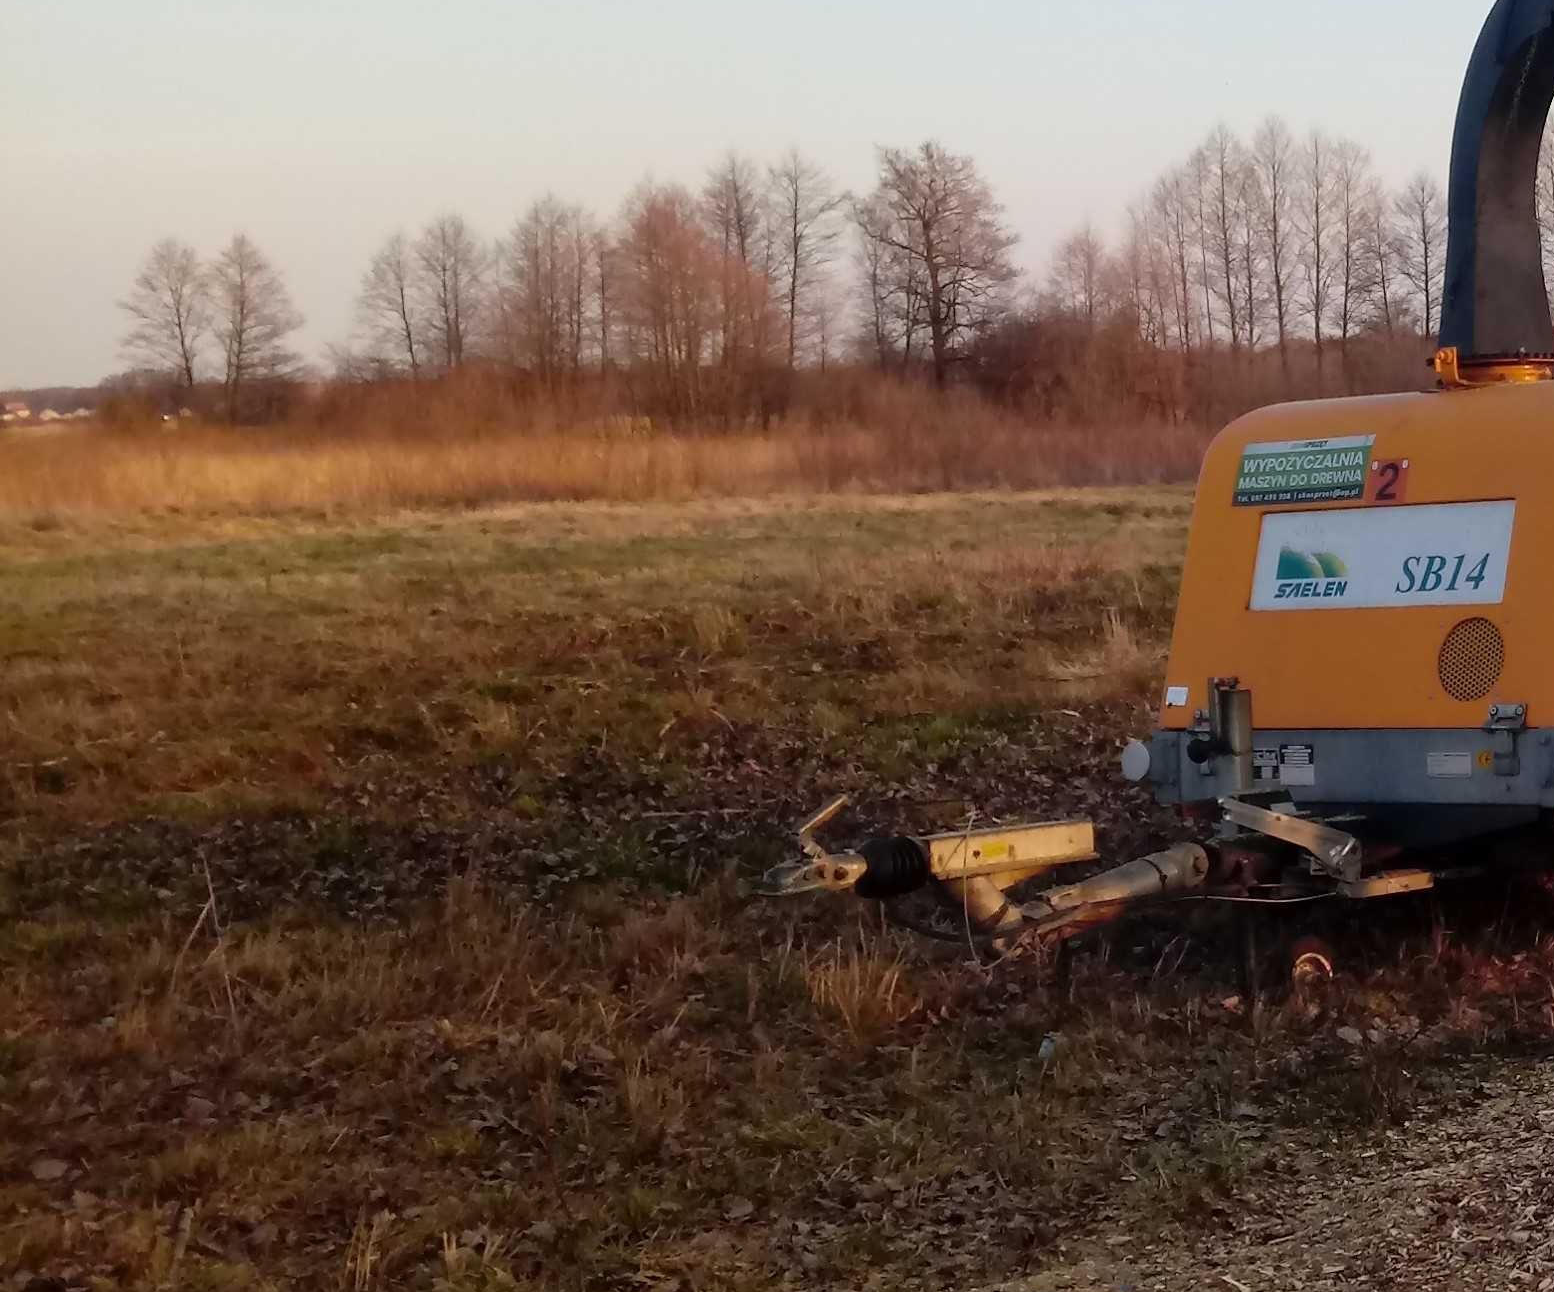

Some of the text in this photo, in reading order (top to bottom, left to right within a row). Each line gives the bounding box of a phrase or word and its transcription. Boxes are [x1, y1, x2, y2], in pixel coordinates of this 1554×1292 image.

[1243, 451, 1364, 473] WYPOŻYCZALNIA
[1238, 469, 1362, 490] MASZYN DO DREWNA
[1378, 462, 1399, 501] 2
[1395, 552, 1491, 593] SB14
[1273, 580, 1348, 599] SAELEN
